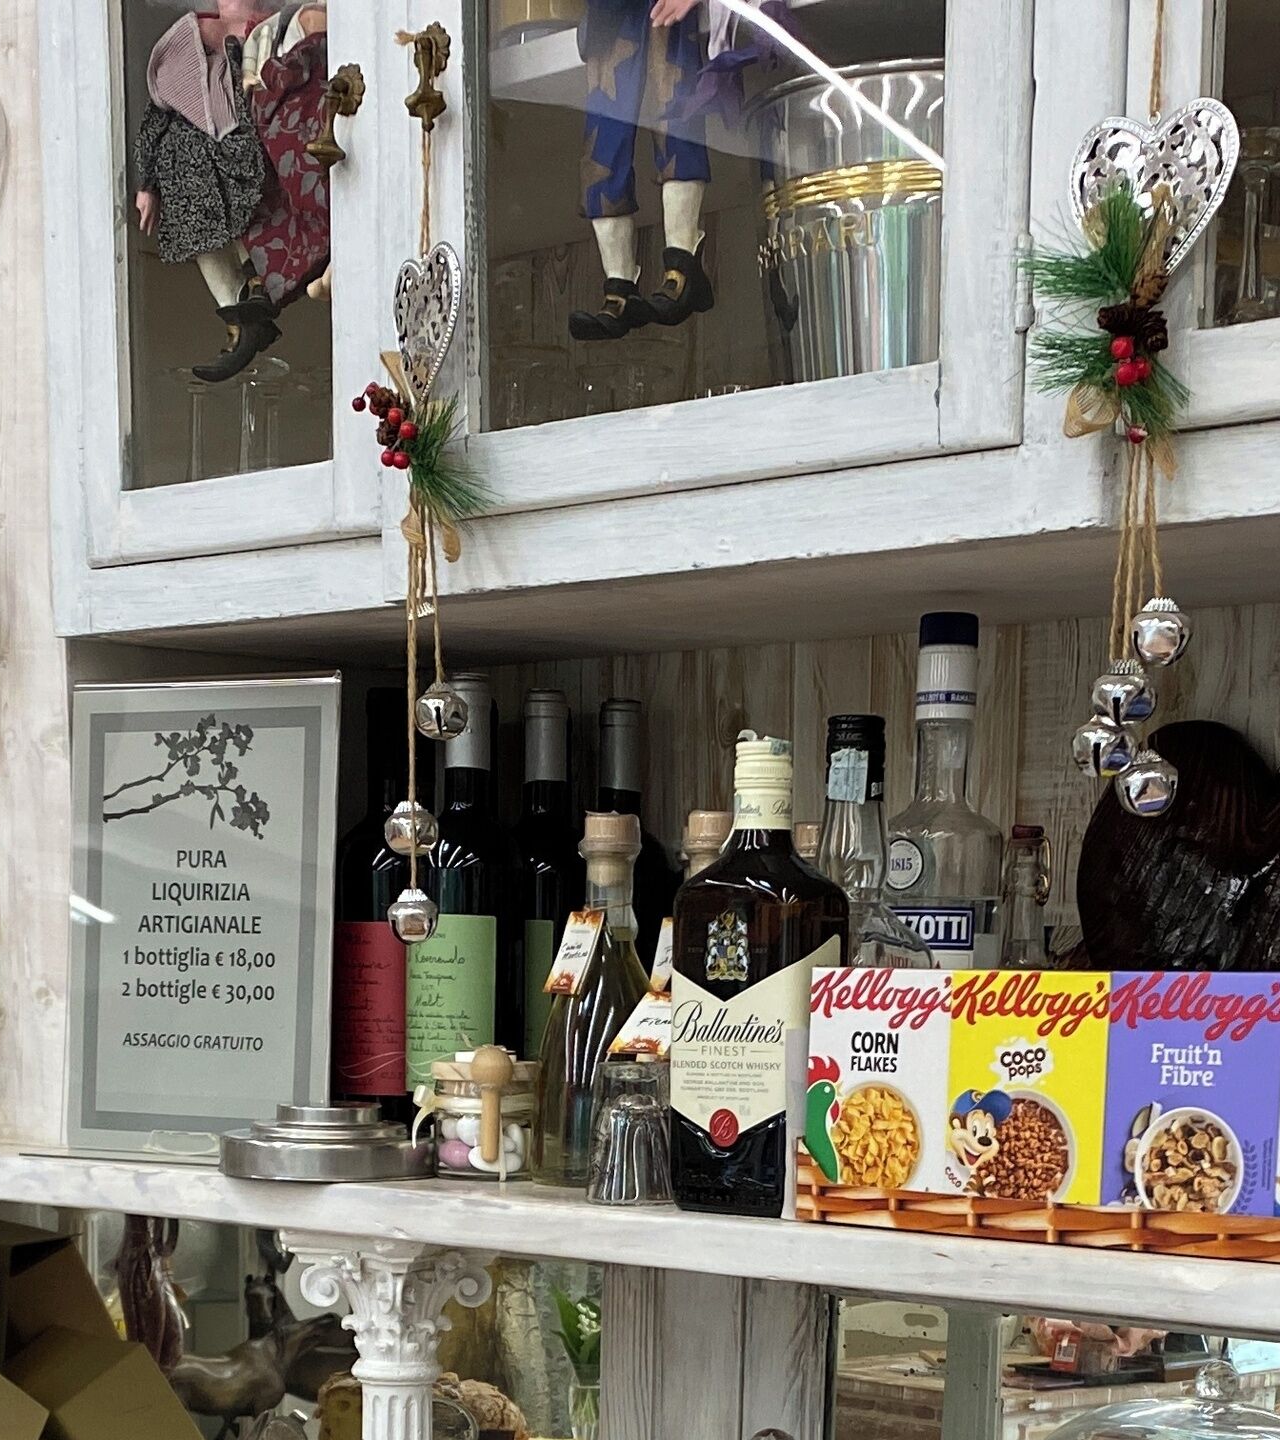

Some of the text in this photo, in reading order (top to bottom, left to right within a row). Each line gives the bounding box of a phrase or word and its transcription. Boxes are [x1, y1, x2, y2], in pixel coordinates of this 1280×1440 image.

[176, 850, 227, 868] PURA
[890, 857, 913, 872] 1815
[151, 882, 251, 906] LIQUIRIZIA
[138, 915, 262, 934] ARTIGIANALE
[905, 914, 968, 941] ZOTTI
[123, 946, 276, 972] 1 bottiglia € 18,00
[121, 978, 275, 1005] 2 bottigle € 30,00
[810, 967, 952, 1030] Kellogg's
[950, 970, 1113, 1037] Kellogg's
[672, 999, 785, 1044] Ballantine's
[122, 1033, 264, 1051] ASSAGGIO GRATUITO
[700, 1045, 747, 1057] FINEST
[851, 1031, 900, 1054] CORN
[672, 1060, 782, 1071] BLENDED SCOTCH WHISKY
[851, 1055, 898, 1073] FLAKES
[1150, 1043, 1224, 1066] Fruit'n
[1008, 1060, 1043, 1081] pops
[1160, 1065, 1215, 1087] Fibre
